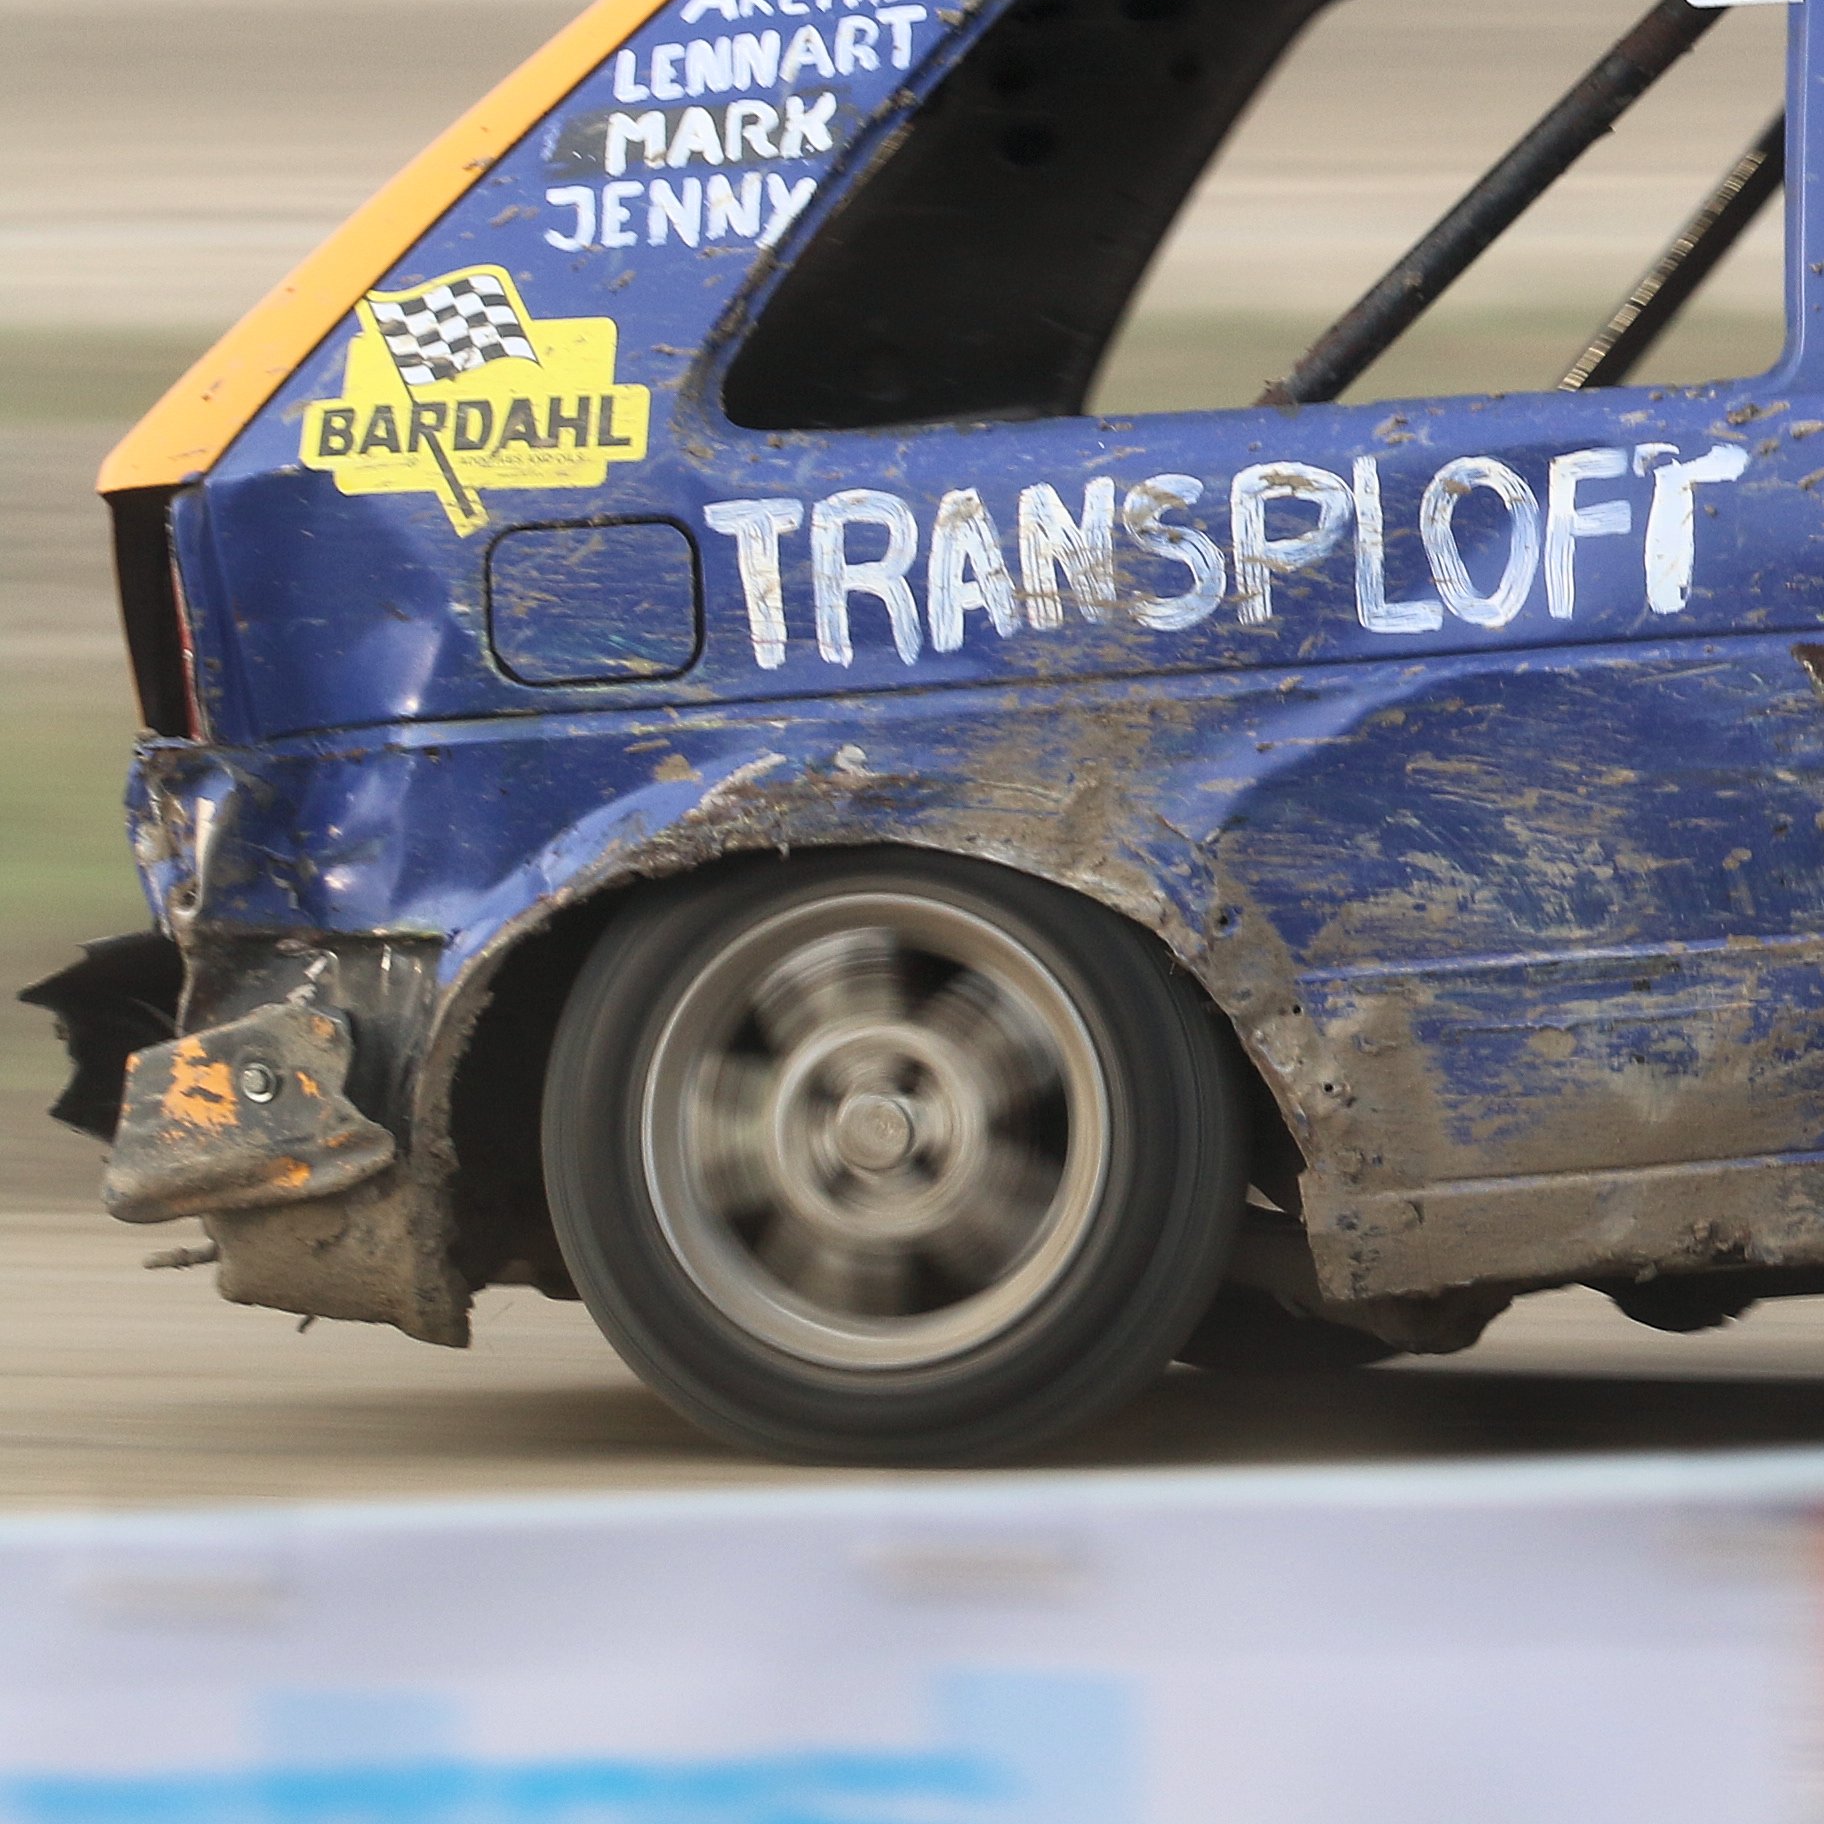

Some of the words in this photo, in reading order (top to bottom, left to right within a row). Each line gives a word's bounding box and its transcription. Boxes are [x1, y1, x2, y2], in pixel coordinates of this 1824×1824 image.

[613, 4, 928, 103] LENNART
[604, 92, 838, 177] MARK
[544, 172, 818, 252] JENNY
[318, 395, 632, 457] BARDAHL
[703, 443, 1749, 671] TRANSPLOFT
